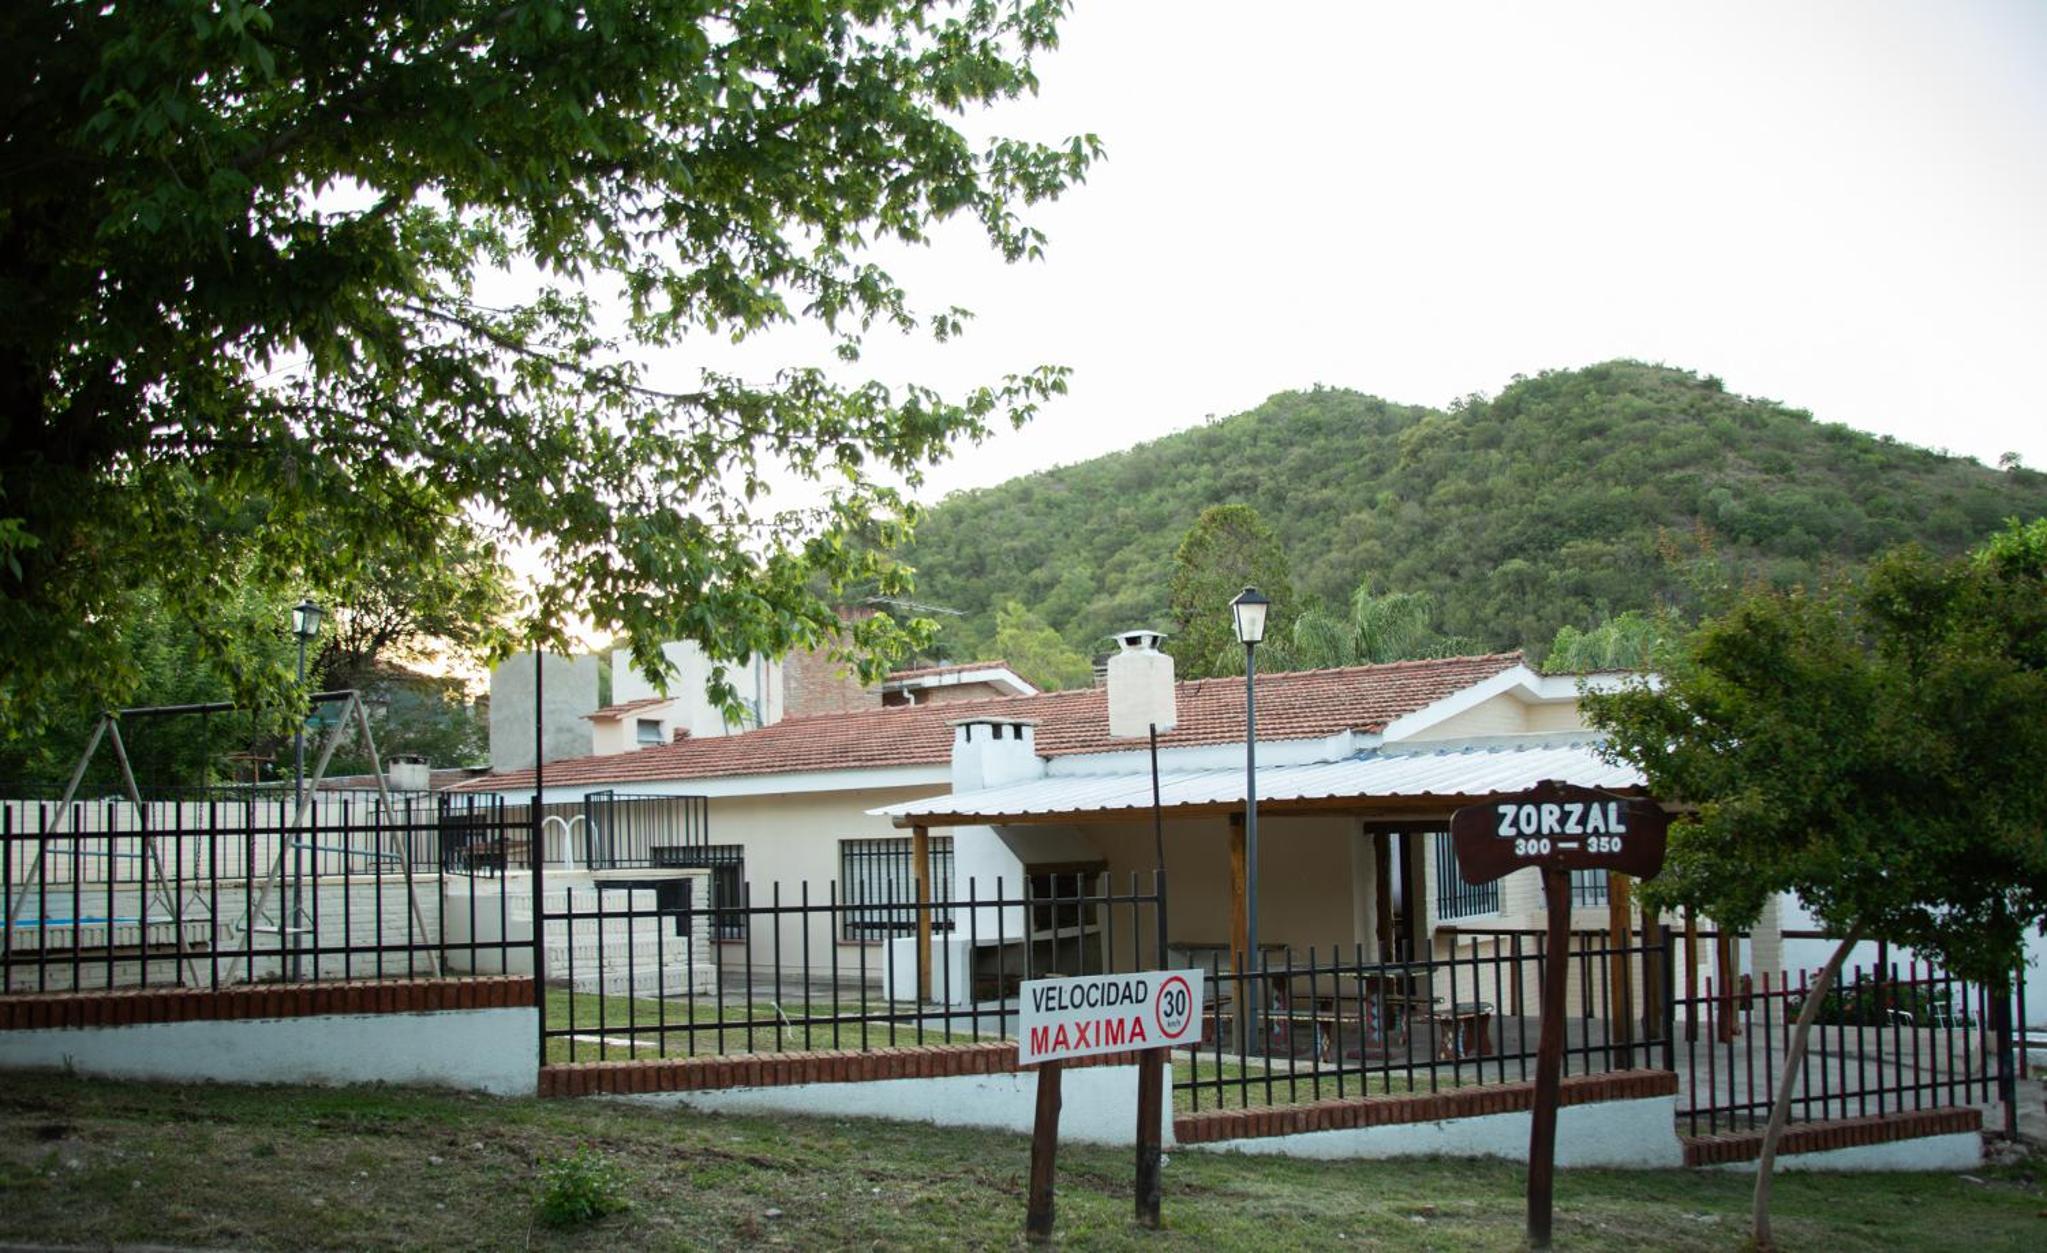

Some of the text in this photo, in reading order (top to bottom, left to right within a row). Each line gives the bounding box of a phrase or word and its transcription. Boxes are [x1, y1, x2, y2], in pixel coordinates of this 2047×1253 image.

[1497, 801, 1627, 836] ZORZAL
[1514, 838, 1551, 856] 300
[1587, 836, 1622, 853] 350
[1032, 980, 1148, 1013] VELOCIDAD
[1163, 989, 1186, 1018] 30
[1030, 1016, 1147, 1056] MAXIMA
